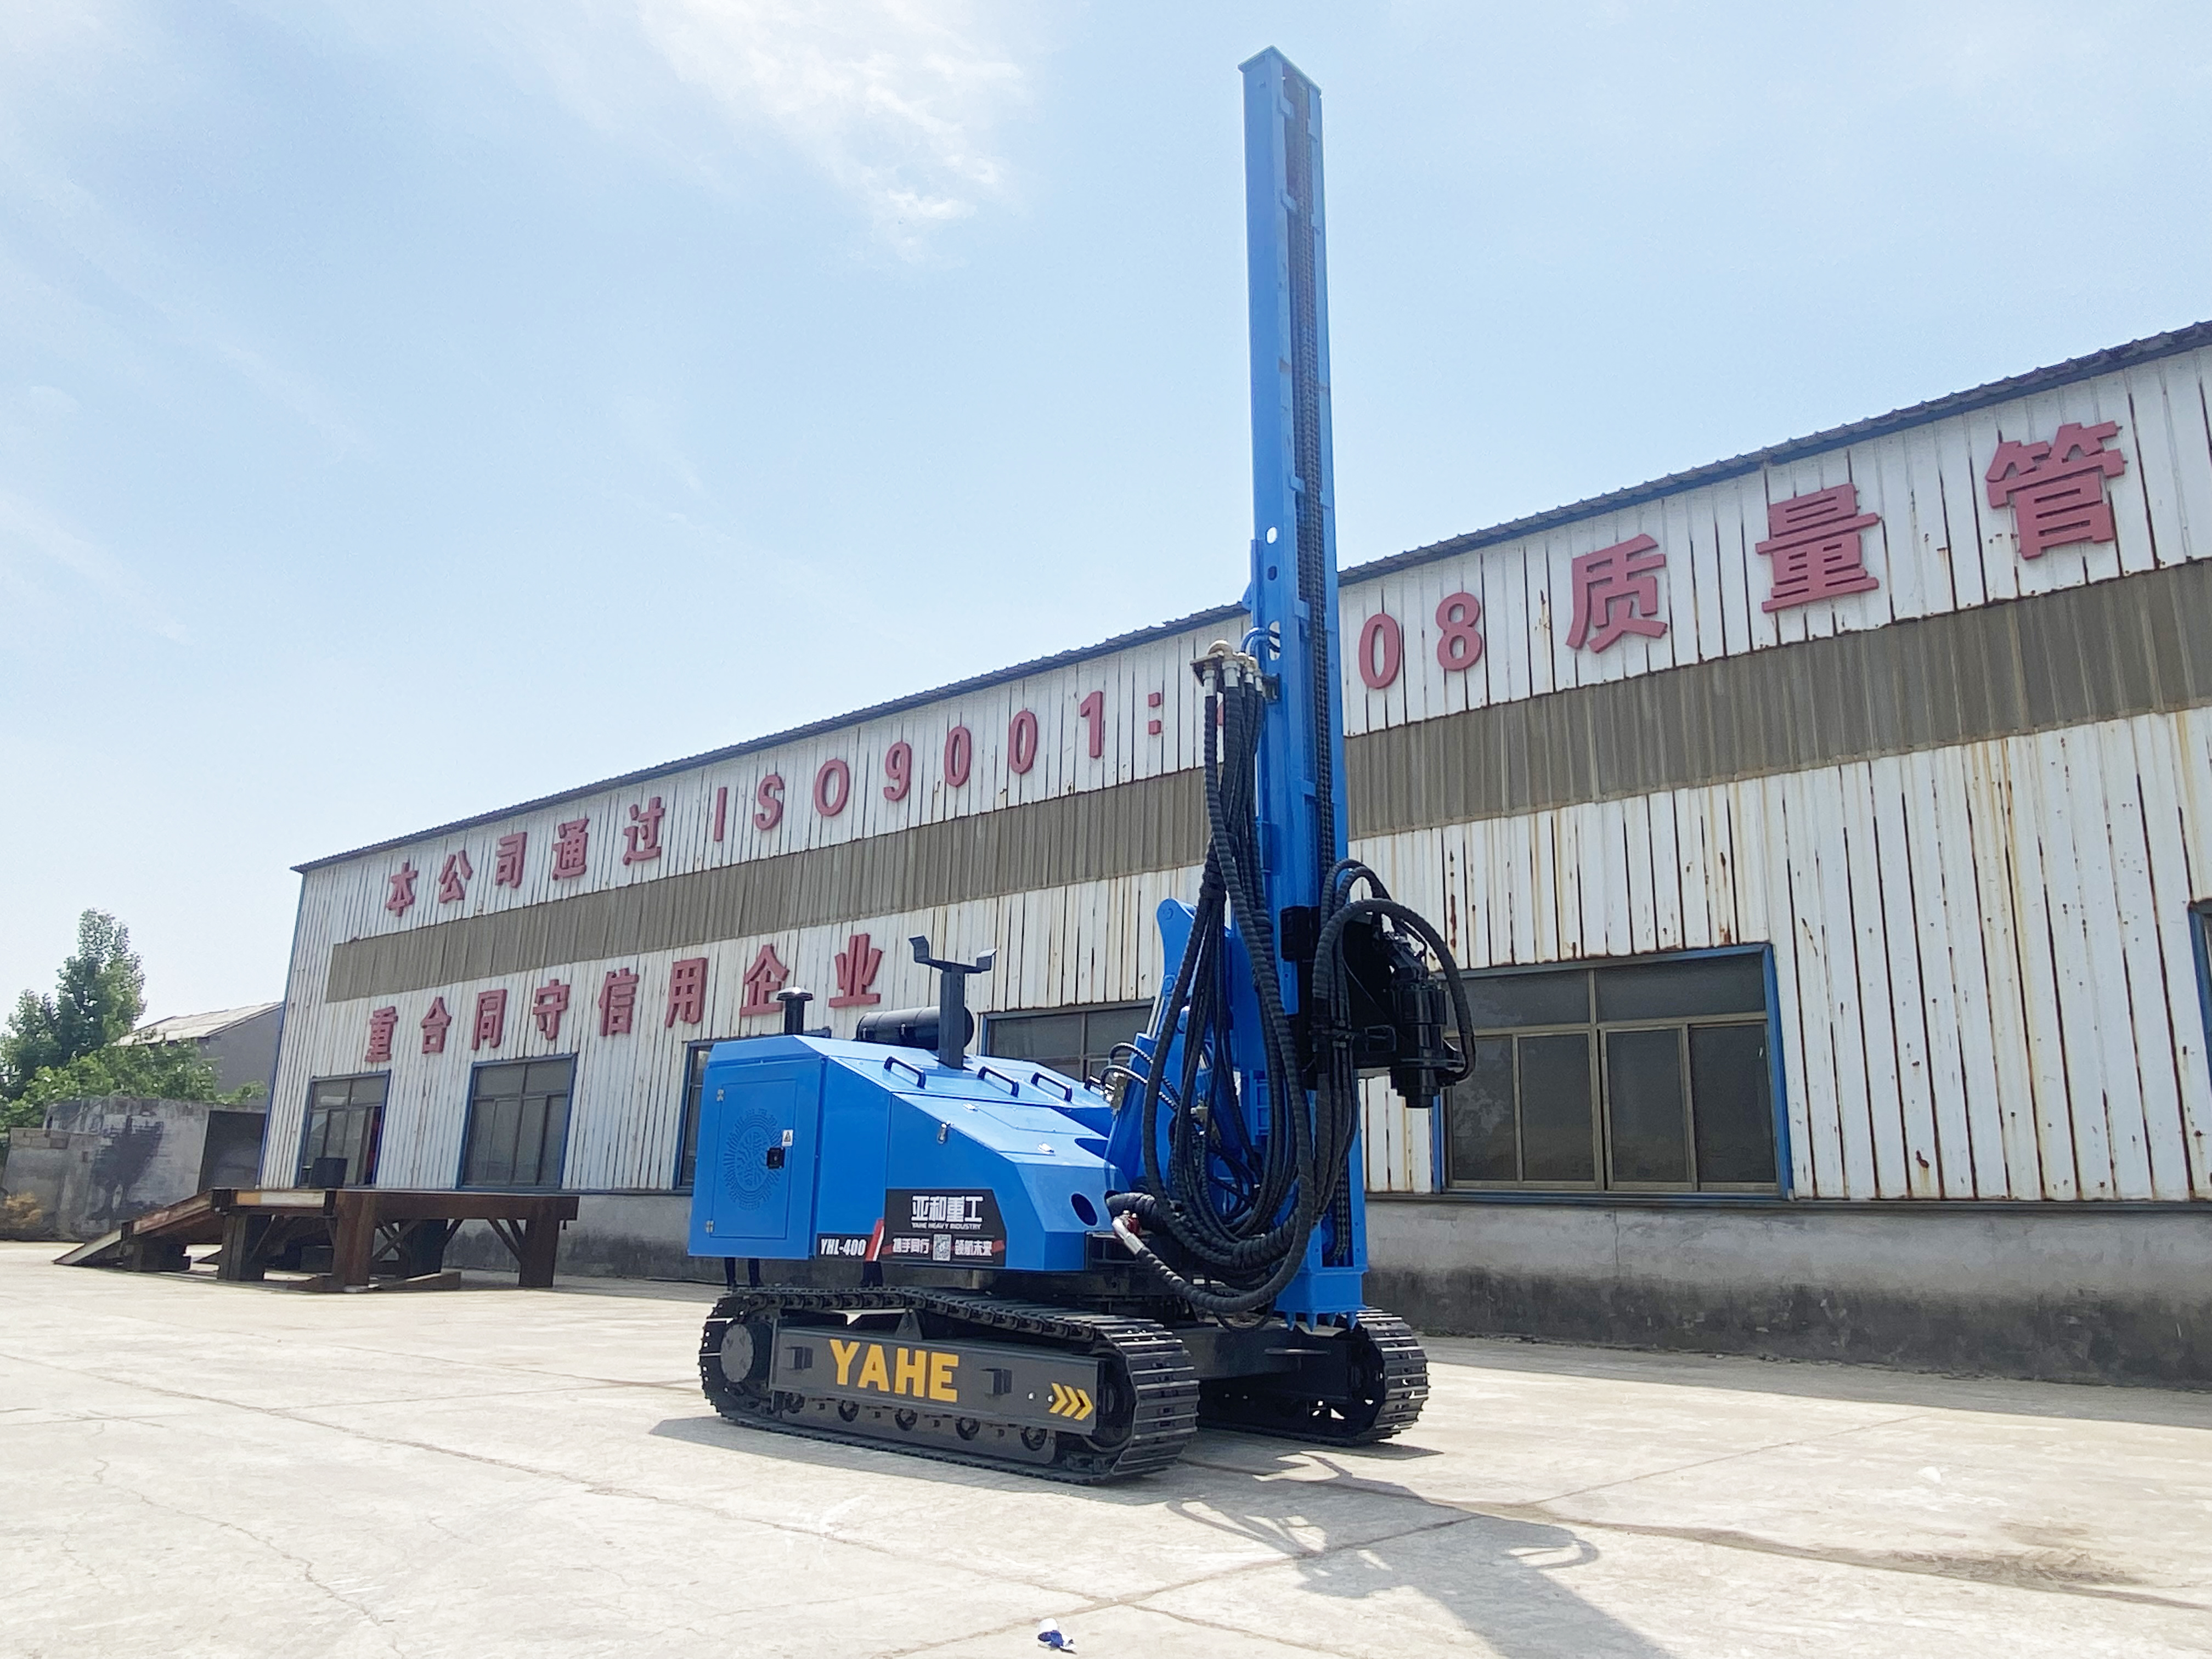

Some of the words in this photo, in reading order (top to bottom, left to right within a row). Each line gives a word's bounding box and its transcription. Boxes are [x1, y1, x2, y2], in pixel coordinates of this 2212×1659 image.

[365, 932, 883, 1063] 重合同守信用企业
[911, 1195, 984, 1222] 亚和重工
[821, 1239, 867, 1256] YHL-400
[830, 1339, 959, 1403] YAHE
